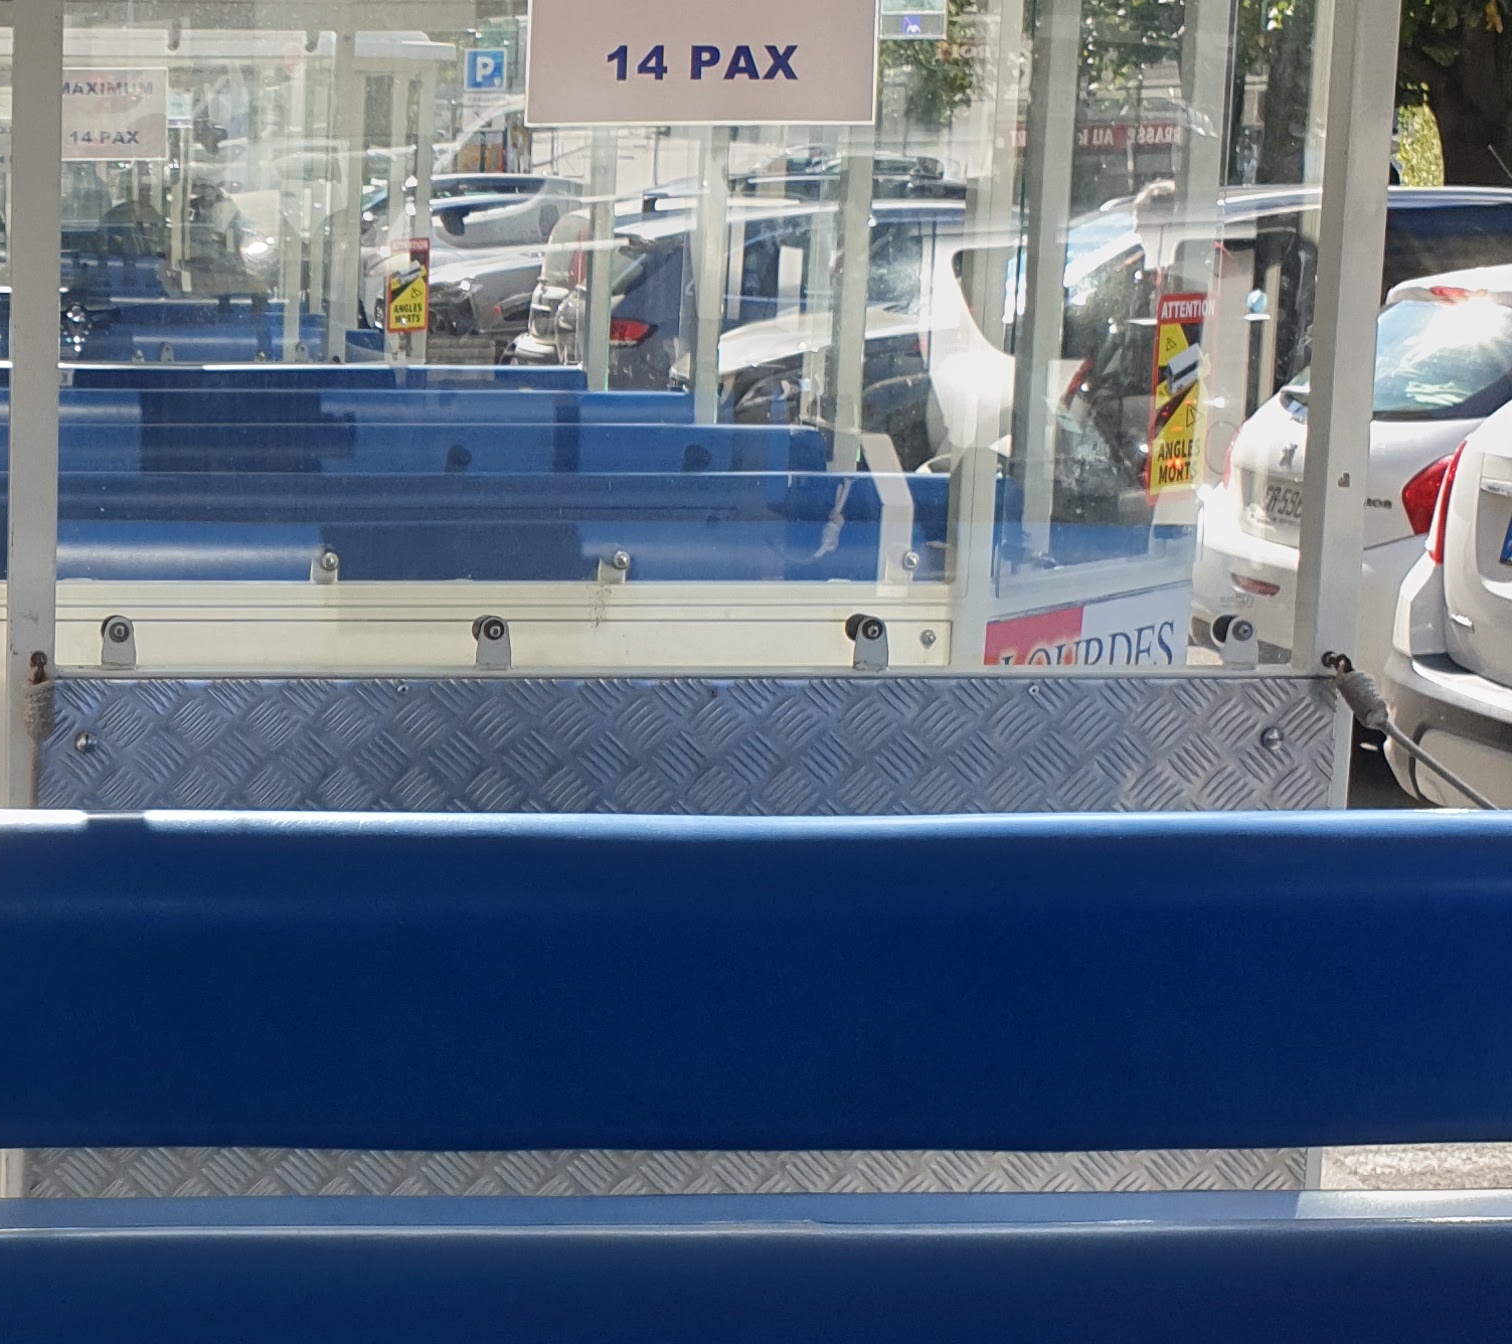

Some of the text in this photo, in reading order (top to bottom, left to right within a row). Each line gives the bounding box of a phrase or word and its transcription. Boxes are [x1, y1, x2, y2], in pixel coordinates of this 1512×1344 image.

[475, 56, 495, 83] P
[606, 44, 800, 81] 14 PAX
[61, 81, 154, 96] MAXIMUM
[69, 130, 140, 145] 14 PAX
[394, 303, 423, 314] ANGLES
[1160, 299, 1216, 320] ATTENTION
[1157, 438, 1201, 460] ANGLES
[1157, 460, 1198, 485] MORTS
